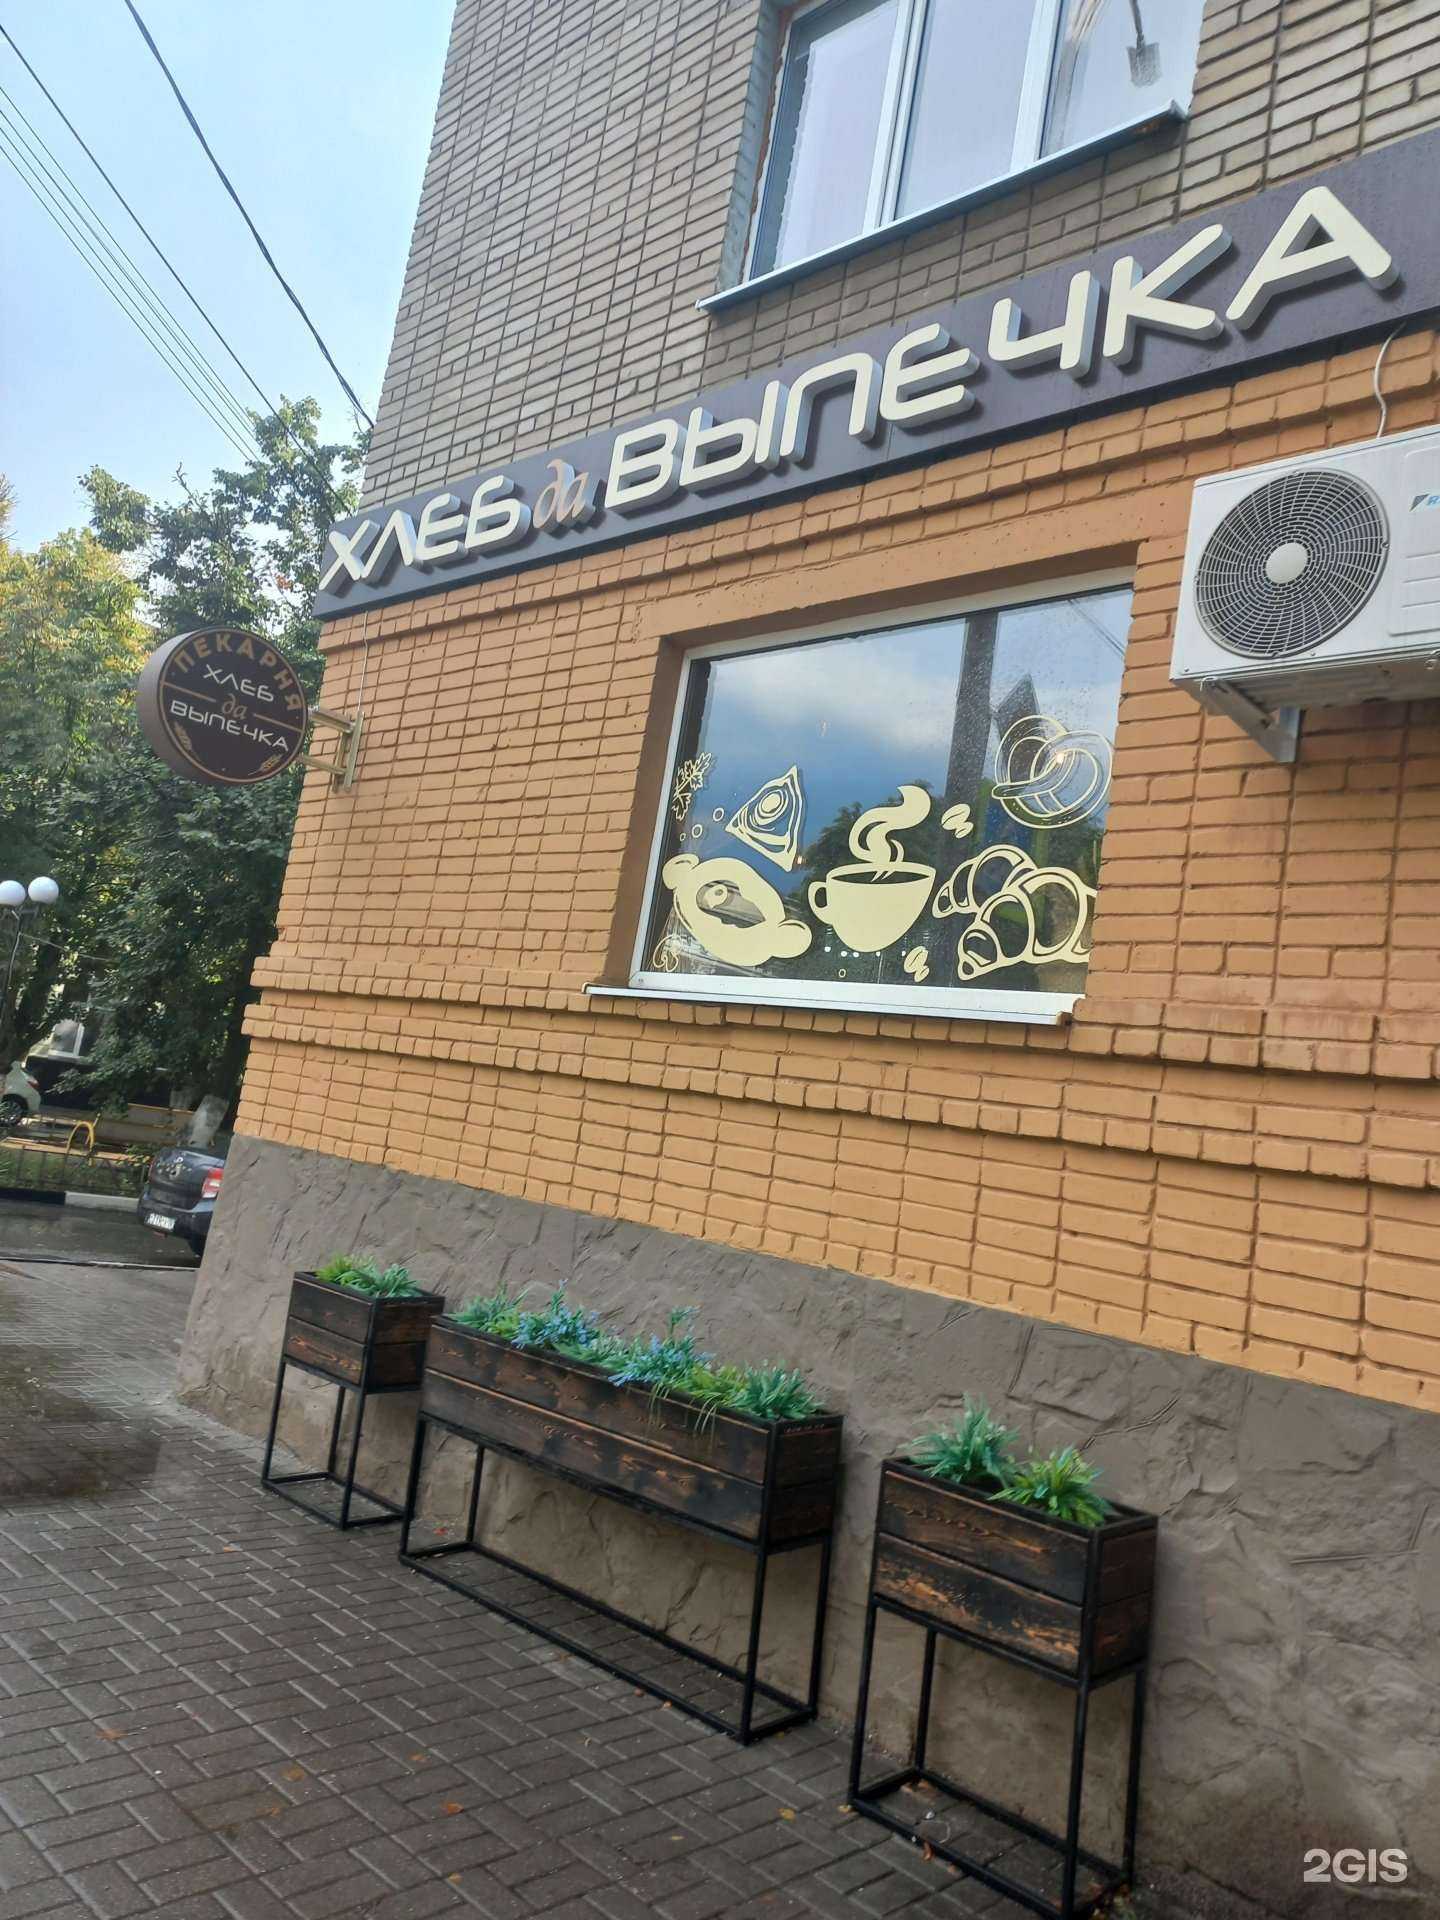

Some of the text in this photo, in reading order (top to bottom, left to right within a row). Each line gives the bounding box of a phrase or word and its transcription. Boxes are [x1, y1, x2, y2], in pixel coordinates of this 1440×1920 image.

[318, 186, 1393, 592] ХЛЕБ да ВЫПЕЧКА
[173, 633, 301, 711] ПЕКАРНЯ
[203, 664, 275, 703] ХЛЕБ
[170, 699, 290, 752] ВЫПЕЧКА
[221, 693, 249, 721] да
